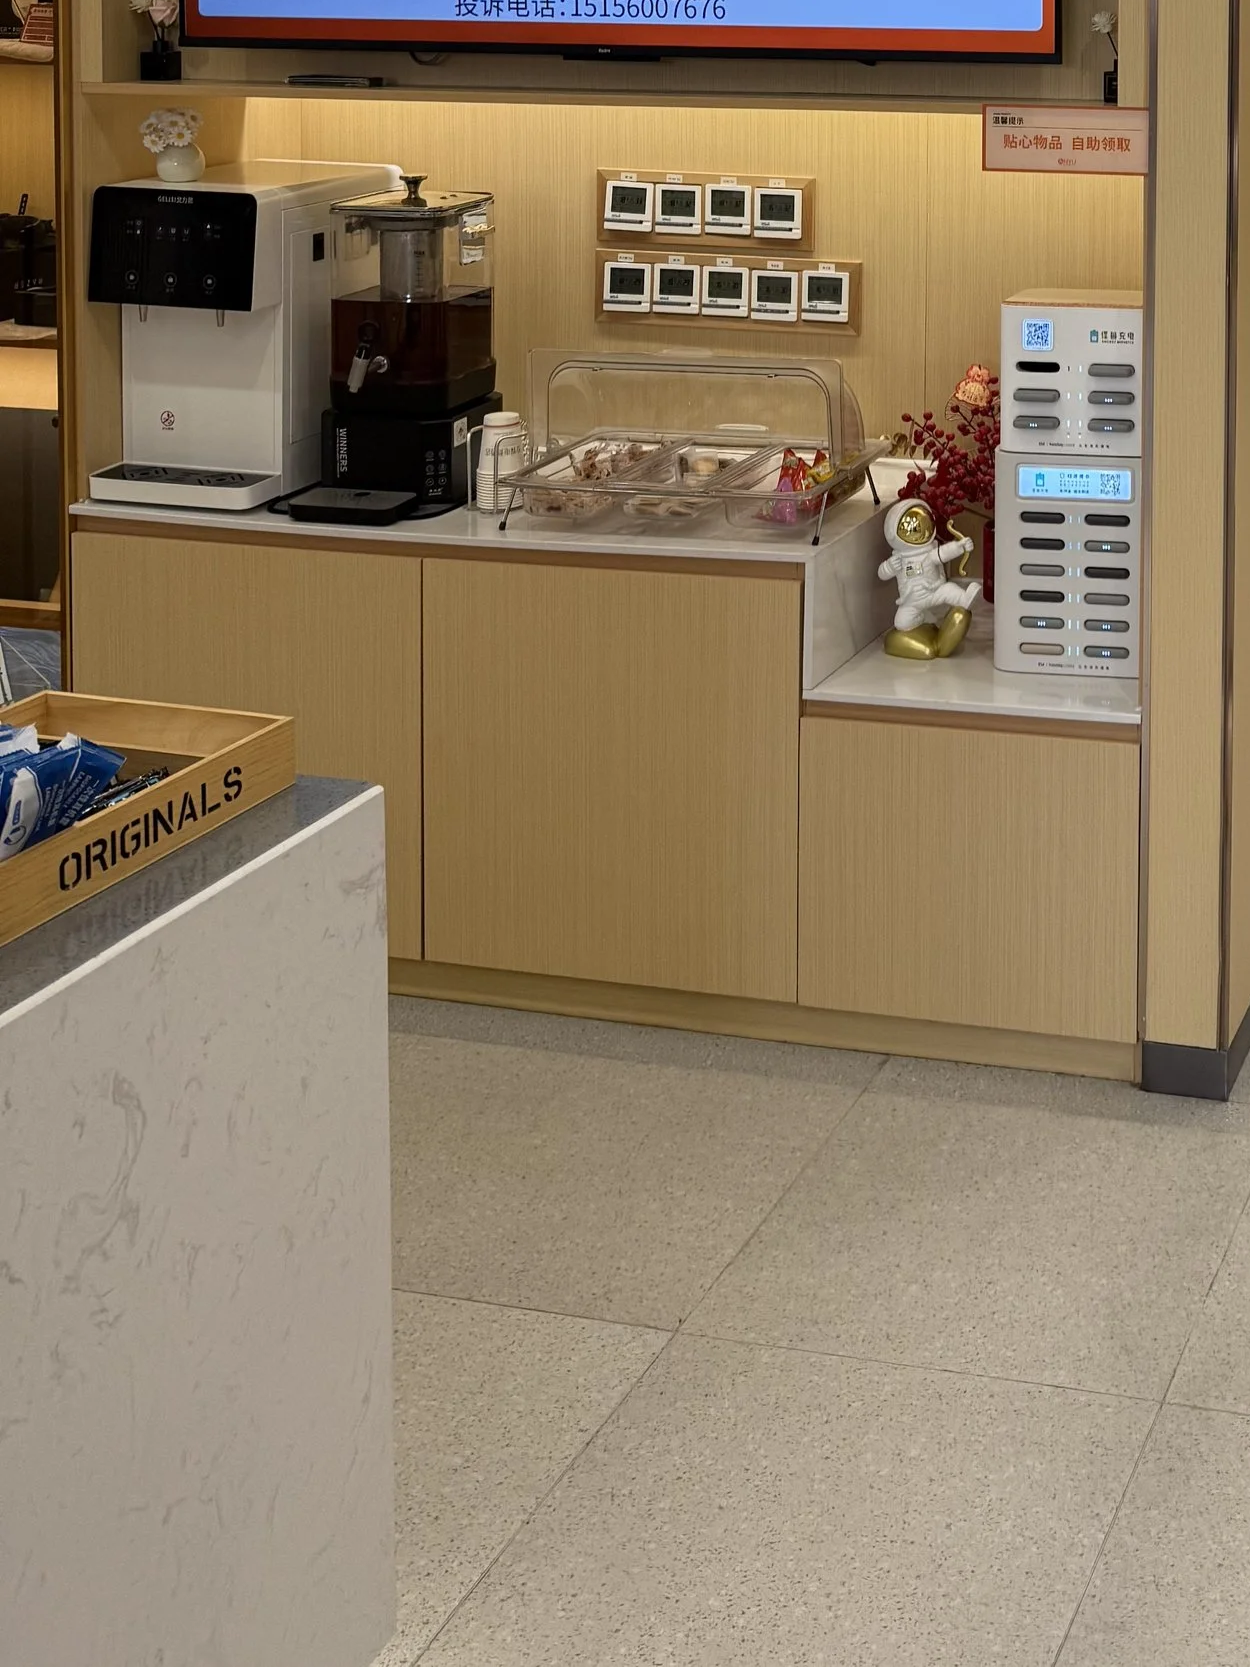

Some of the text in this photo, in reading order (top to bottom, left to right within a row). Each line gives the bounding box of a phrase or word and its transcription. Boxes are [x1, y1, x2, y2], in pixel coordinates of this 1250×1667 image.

[992, 115, 1025, 126] 温馨提示
[1002, 133, 1132, 153] 贴心物品 自助领取
[338, 427, 348, 474] WINNERS
[58, 765, 244, 893] ORIGINALS
